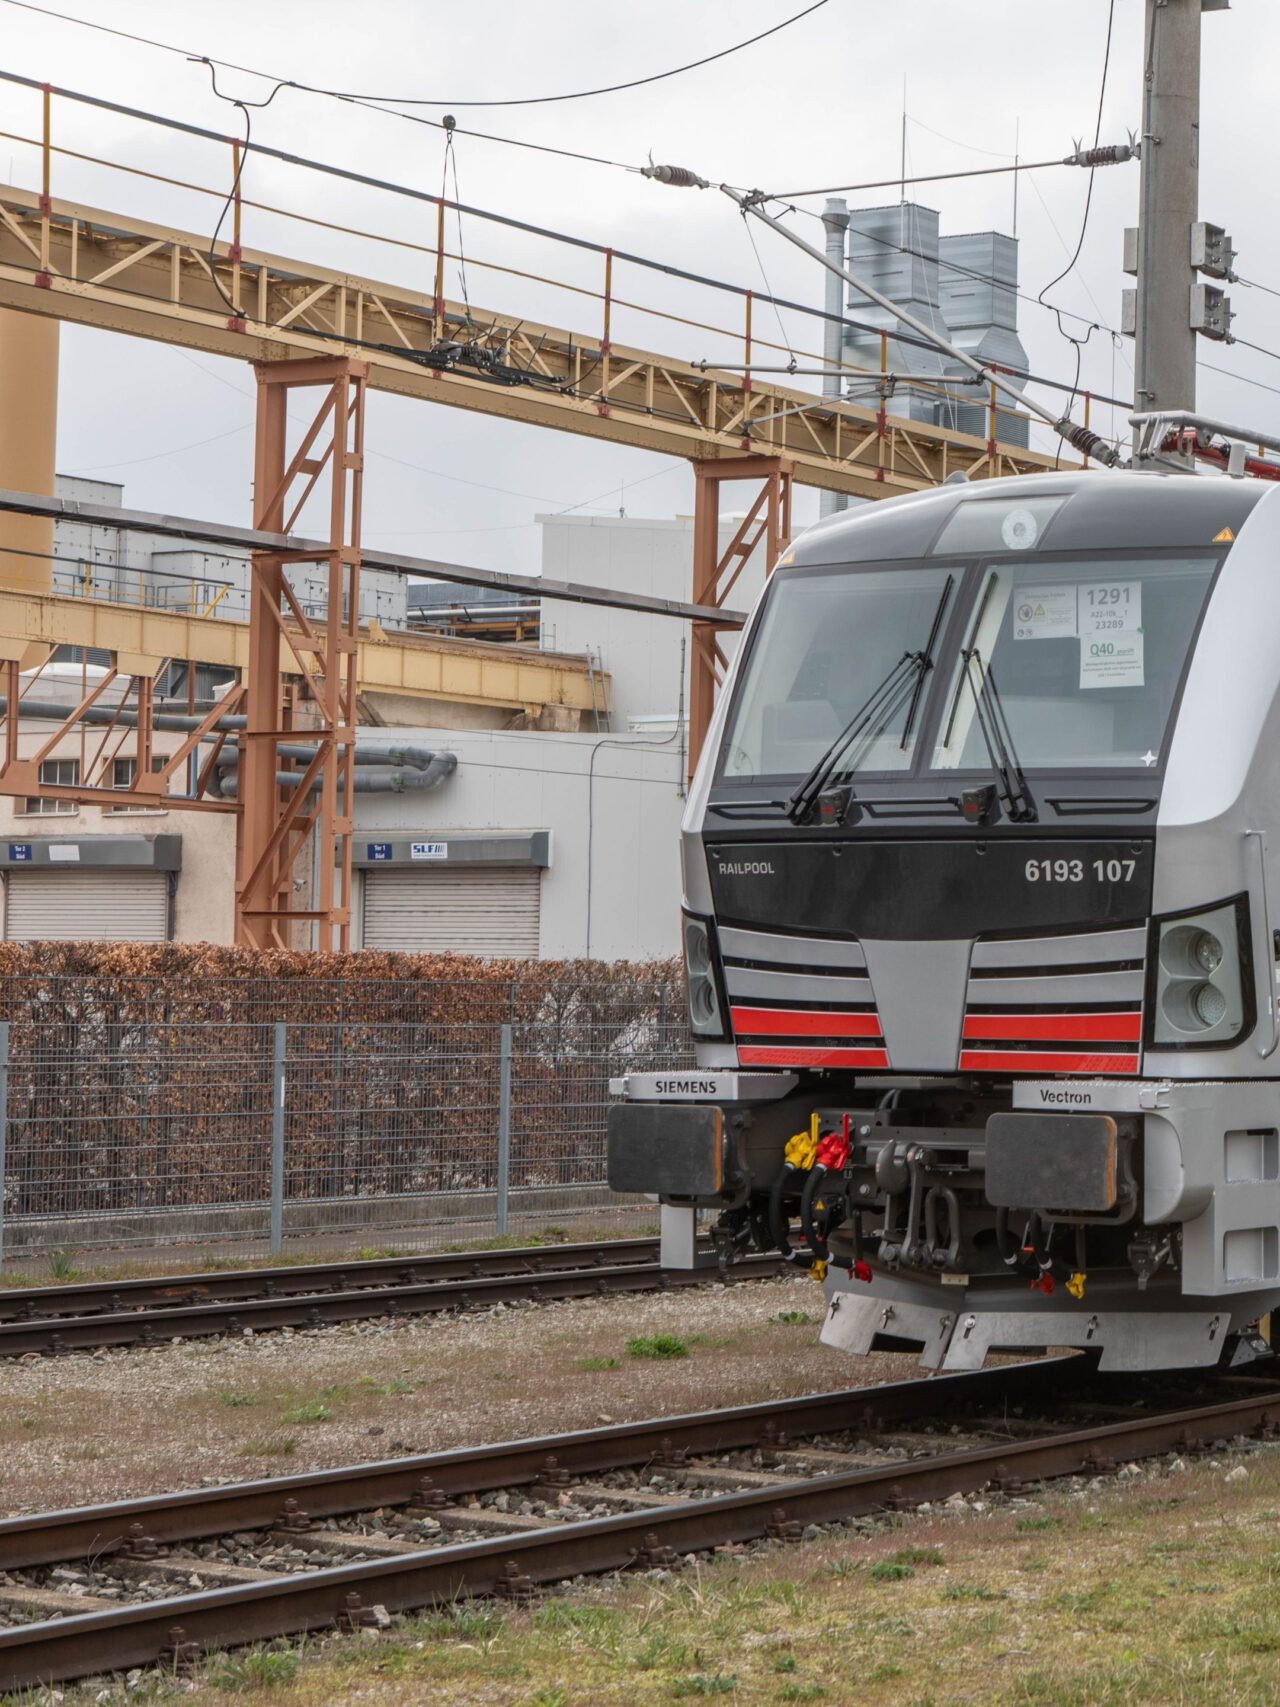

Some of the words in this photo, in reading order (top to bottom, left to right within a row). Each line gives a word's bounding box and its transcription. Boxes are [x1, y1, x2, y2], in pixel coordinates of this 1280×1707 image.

[1087, 587, 1130, 606] 1291
[1095, 620, 1124, 630] 23289
[1090, 643, 1114, 657] Q40
[718, 862, 775, 875] RAILPOOL
[1025, 859, 1084, 881] 6193
[1092, 859, 1136, 881] 107
[655, 1081, 717, 1094] SIEMENS
[1040, 1089, 1092, 1104] Vectron
